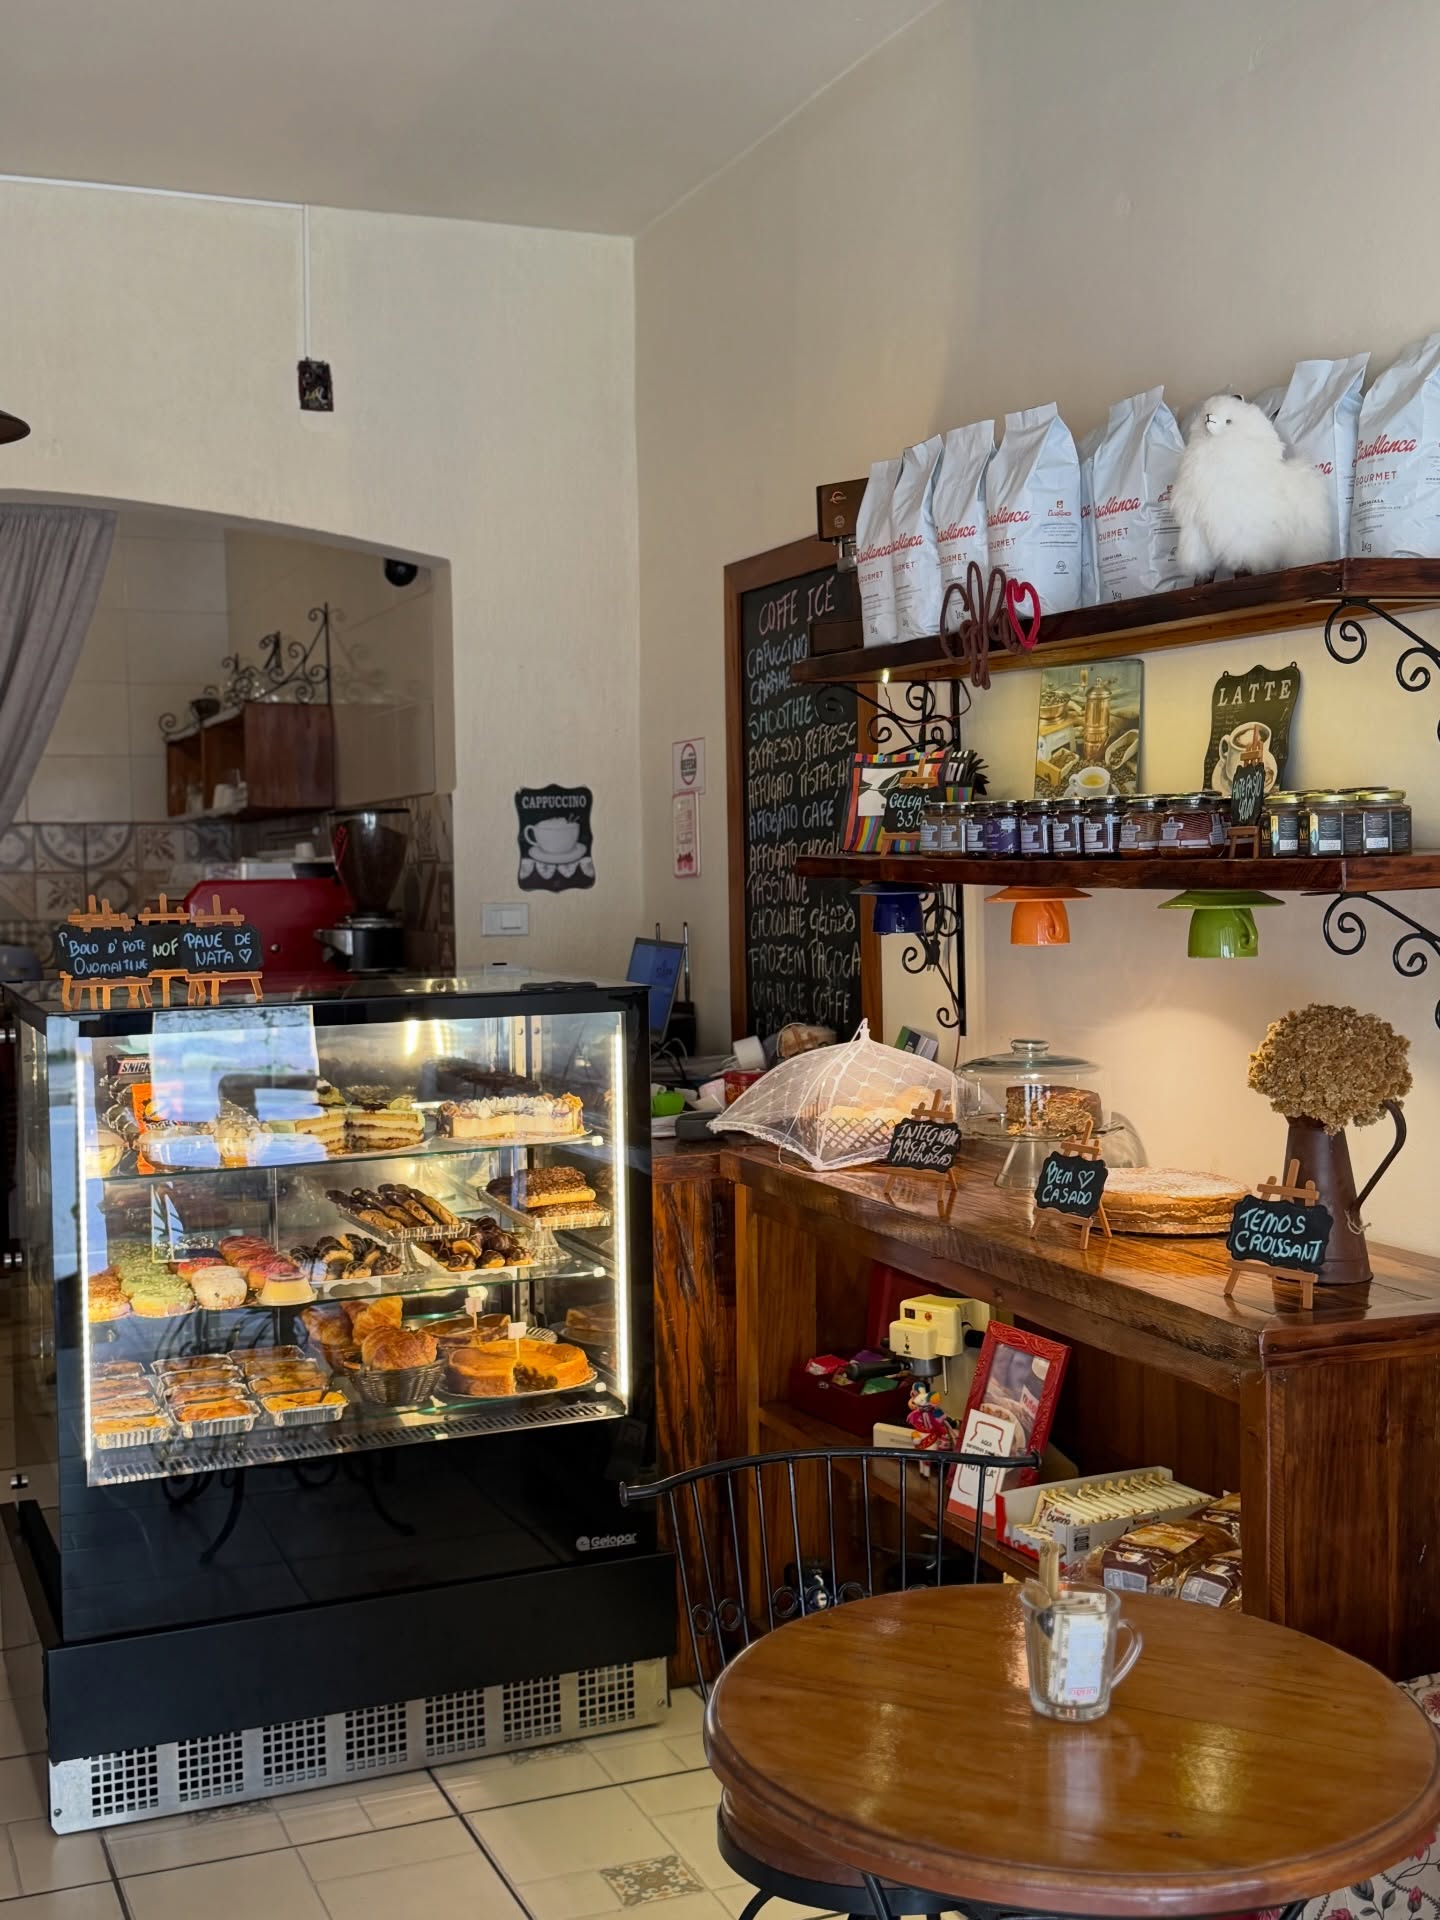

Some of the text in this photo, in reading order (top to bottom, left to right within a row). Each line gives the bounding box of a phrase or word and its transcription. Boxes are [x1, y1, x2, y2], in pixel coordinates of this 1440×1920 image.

[1095, 496, 1141, 519] asablanca
[988, 538, 1016, 550] OURMET
[1098, 527, 1128, 541] OURMET
[940, 552, 967, 564] OURMET
[859, 570, 883, 582] OURMET
[758, 589, 798, 636] COFFE
[807, 576, 836, 621] ICE
[746, 633, 808, 679] CAPUCCINO
[750, 664, 797, 705] CARAME
[1217, 679, 1292, 707] LATTE
[521, 795, 587, 809] CAPPUCCINO
[747, 773, 794, 810] AFFOGATO
[749, 804, 798, 841] AFFOGATO
[749, 838, 798, 876] AFFOGATO
[750, 907, 806, 939] CHOCOLATE
[122, 938, 147, 954] POTE
[234, 932, 251, 946] DE
[195, 948, 234, 967] NATA
[1046, 1160, 1073, 1185] BEM
[1042, 1185, 1093, 1206] CASADO
[1240, 1207, 1306, 1234] TEMOS
[1235, 1230, 1322, 1263] CROISSANT
[1046, 1511, 1071, 1526] bueno
[590, 1532, 637, 1547] Gelopar
